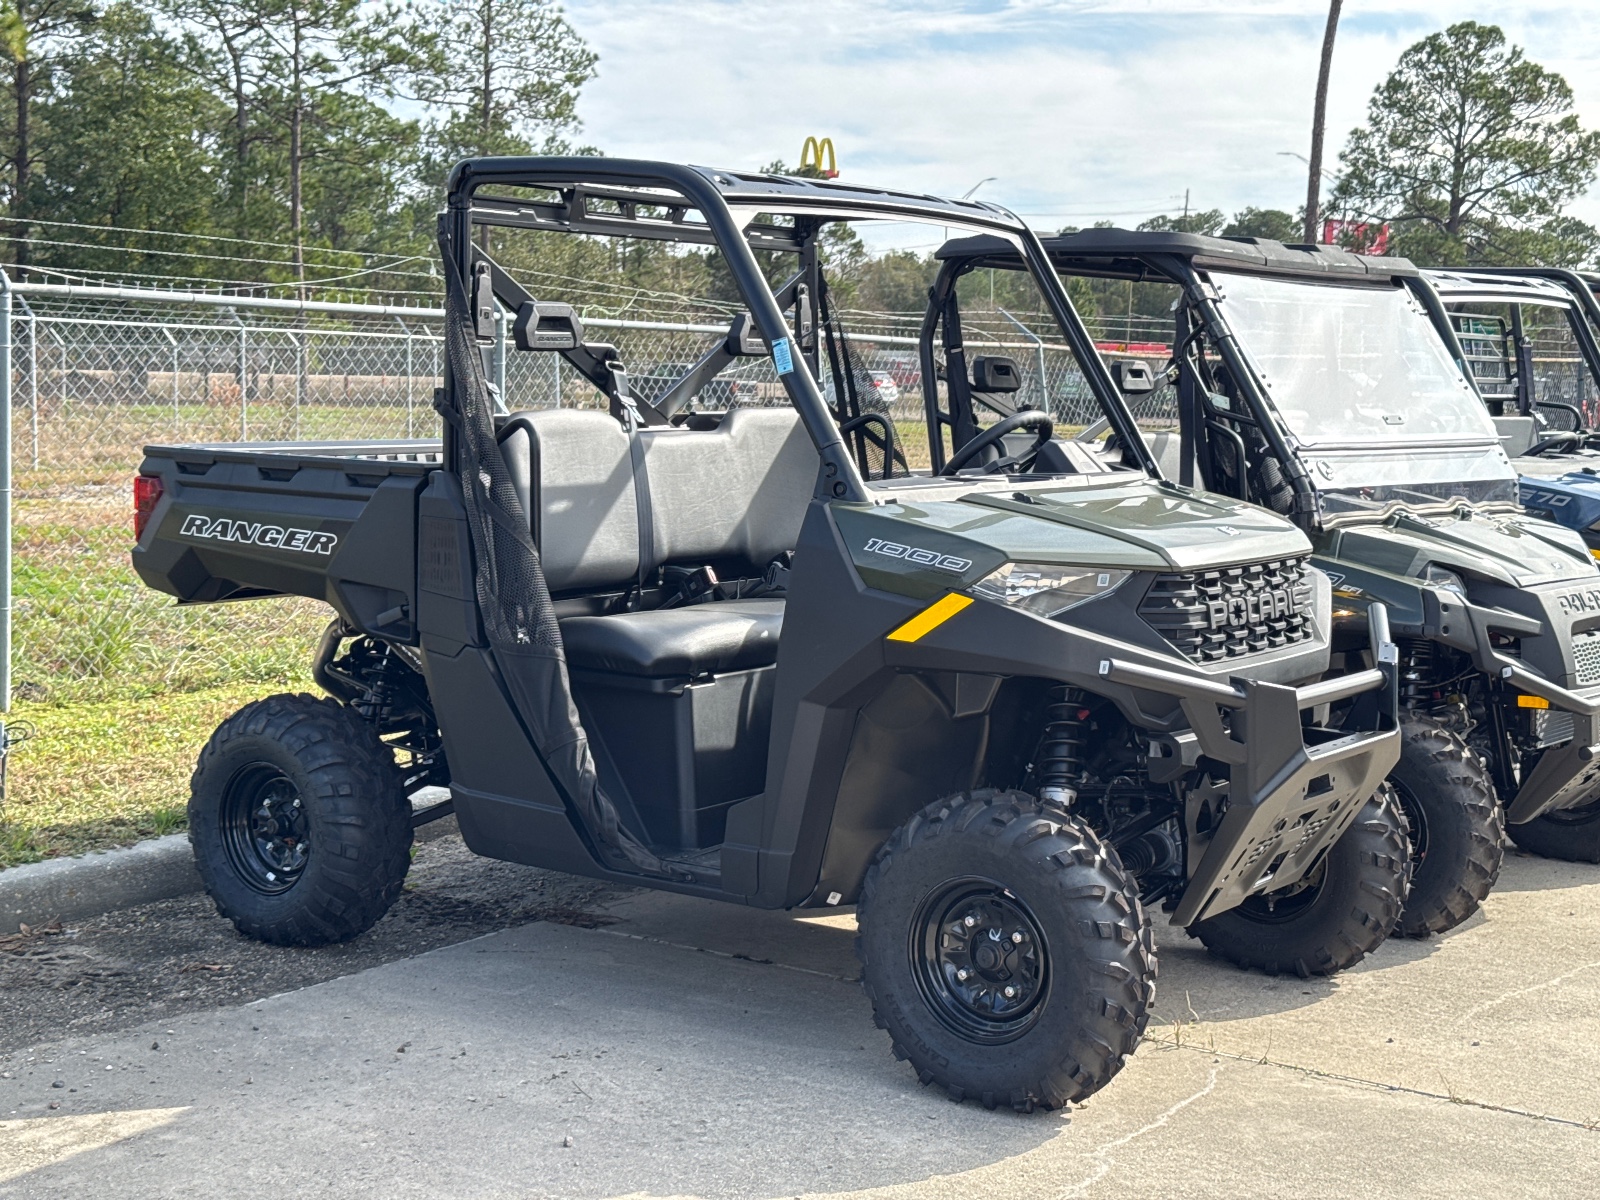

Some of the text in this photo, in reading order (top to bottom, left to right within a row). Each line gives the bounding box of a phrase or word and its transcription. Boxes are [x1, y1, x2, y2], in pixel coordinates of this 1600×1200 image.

[1519, 488, 1572, 507] 570
[180, 514, 338, 555] RANGER
[863, 538, 972, 572] 1000
[1340, 584, 1364, 595] EFI
[1209, 585, 1309, 630] POLARIS
